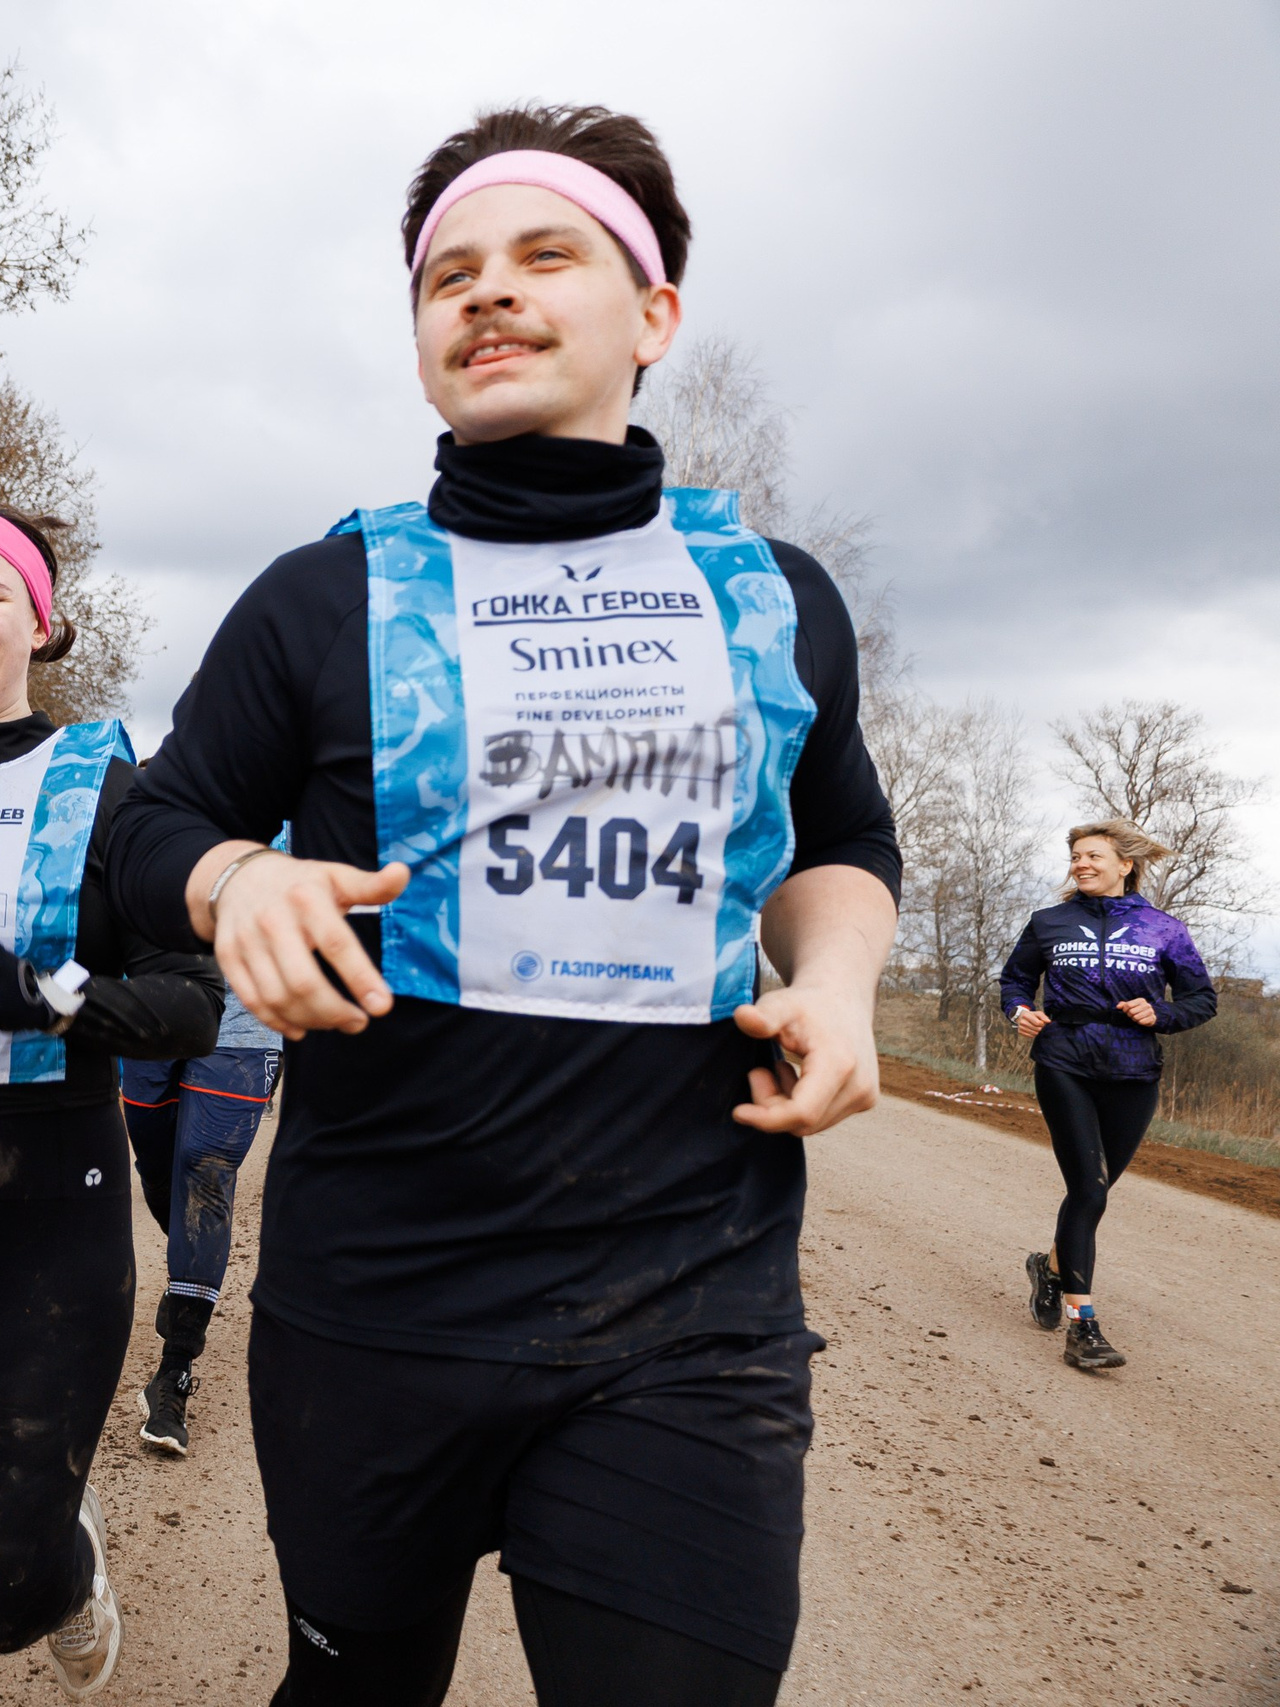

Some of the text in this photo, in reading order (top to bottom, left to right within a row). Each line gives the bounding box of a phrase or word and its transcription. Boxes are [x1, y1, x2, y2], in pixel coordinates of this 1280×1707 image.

[472, 591, 702, 617] ГОНКА ГЕРОЕВ
[510, 637, 679, 673] Sminex
[515, 684, 686, 702] ПЕРФЕКЦИОНИСТЫ
[516, 704, 686, 722] FINE DEVELOPMENT
[486, 814, 704, 905] 5404
[1053, 942, 1156, 957] ГОНКА ГЕРОЕВ
[550, 961, 675, 982] ГАЗПРОМБАНК
[264, 1051, 279, 1094] ILA
